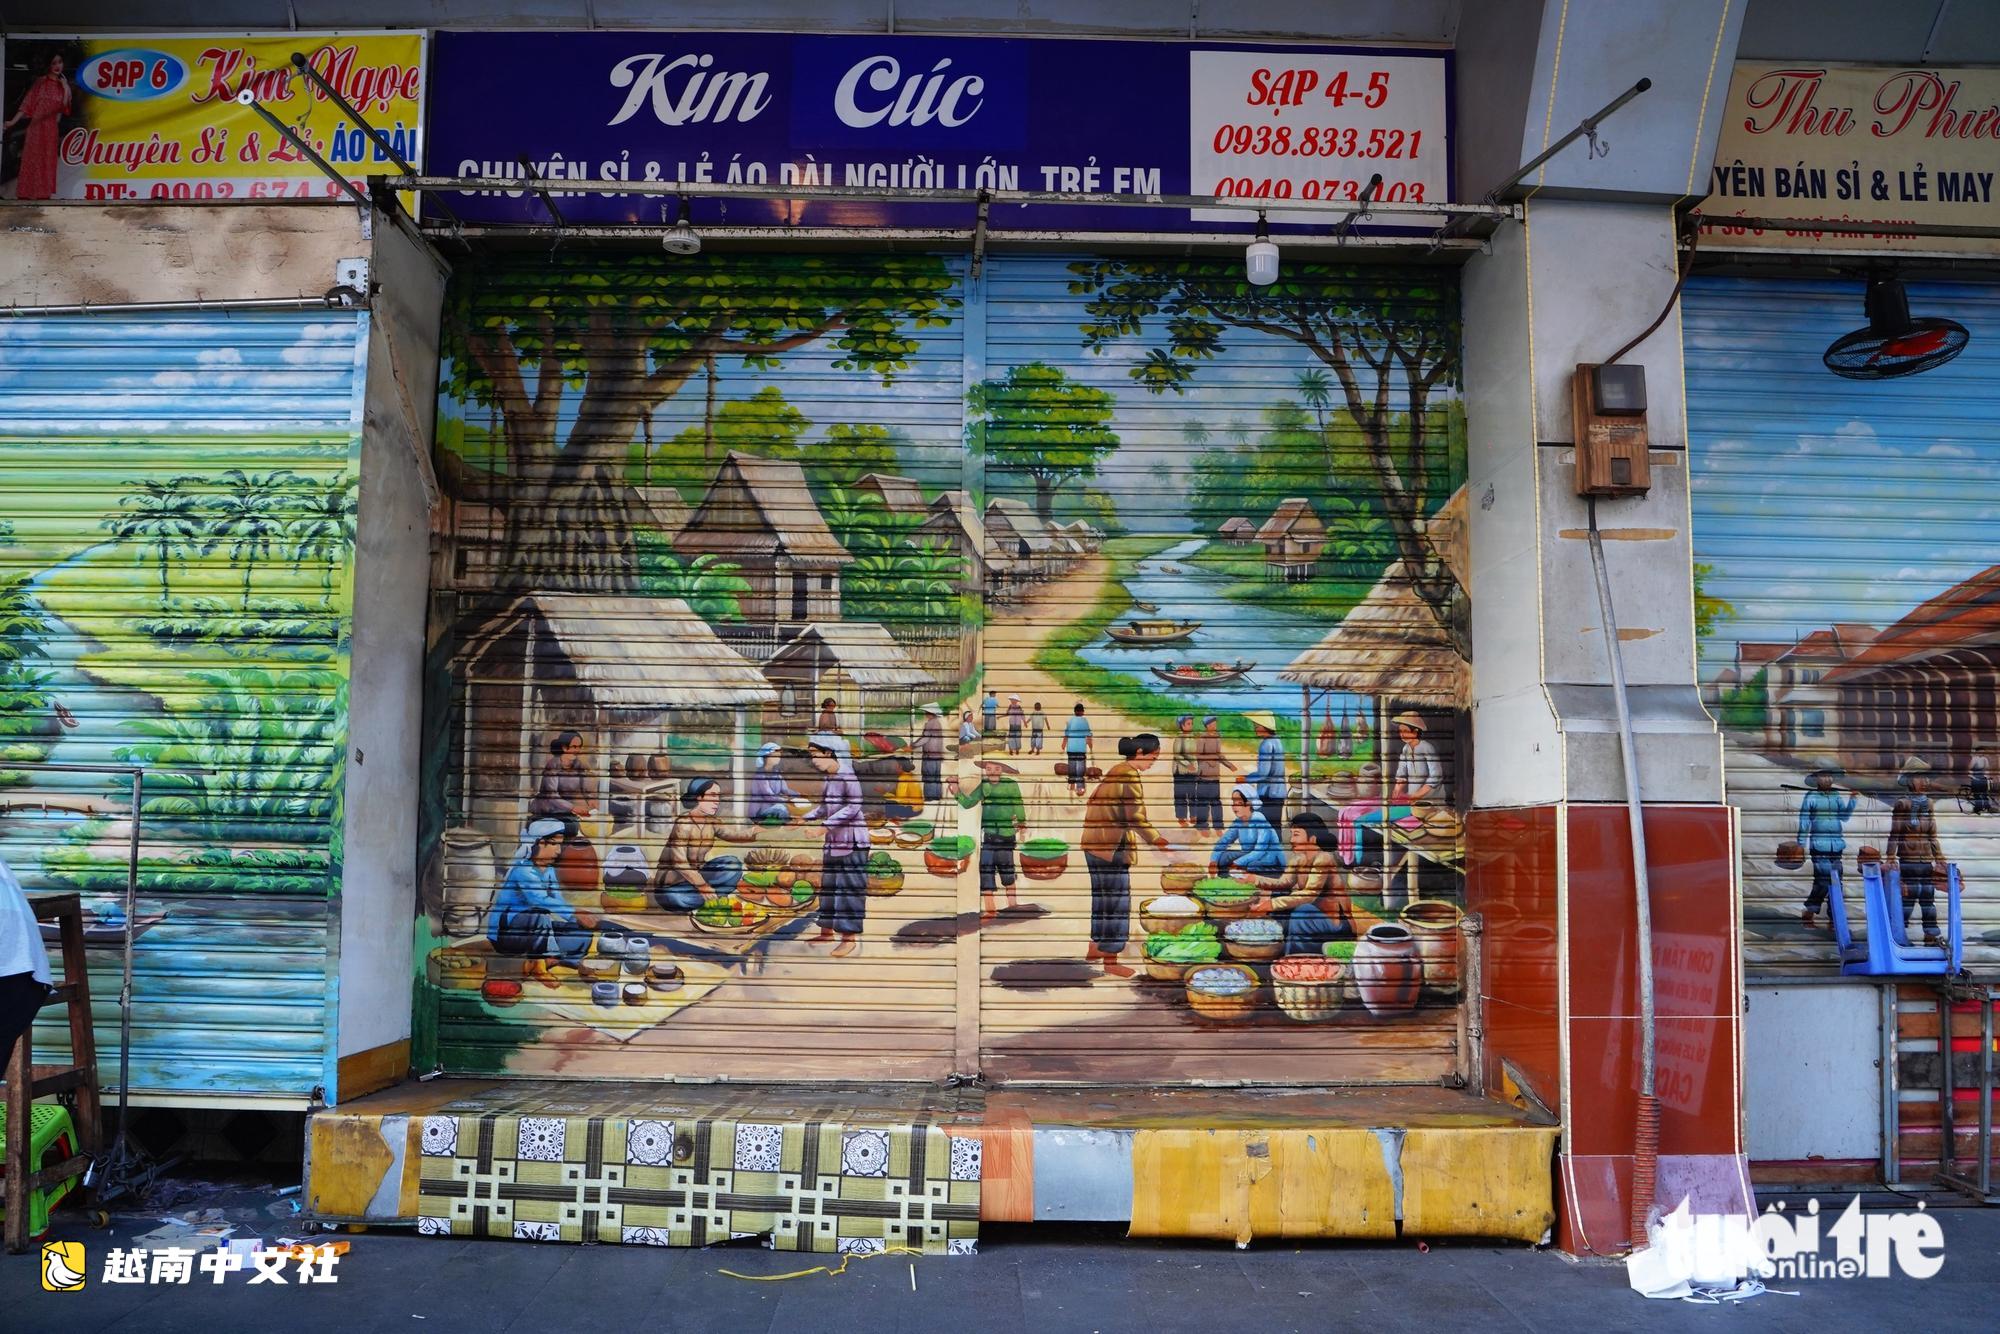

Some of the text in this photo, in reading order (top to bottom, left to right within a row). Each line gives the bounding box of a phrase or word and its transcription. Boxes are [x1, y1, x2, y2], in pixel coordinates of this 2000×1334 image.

[97, 58, 169, 95] SẠP 6
[192, 47, 297, 105] Kim
[607, 53, 984, 128] Kim Cúc
[1246, 68, 1390, 117] SẠP 4-5
[1744, 69, 1856, 136] Thu
[60, 127, 182, 171] Chuyên
[191, 126, 228, 165] Sỉ
[238, 131, 261, 163] &
[330, 121, 366, 162] ÁO
[1213, 124, 1422, 160] 0938.833.521
[458, 152, 588, 198] CHUYÊN
[1710, 159, 1994, 203] YÊN BÁN SỈ & LẺ MAY
